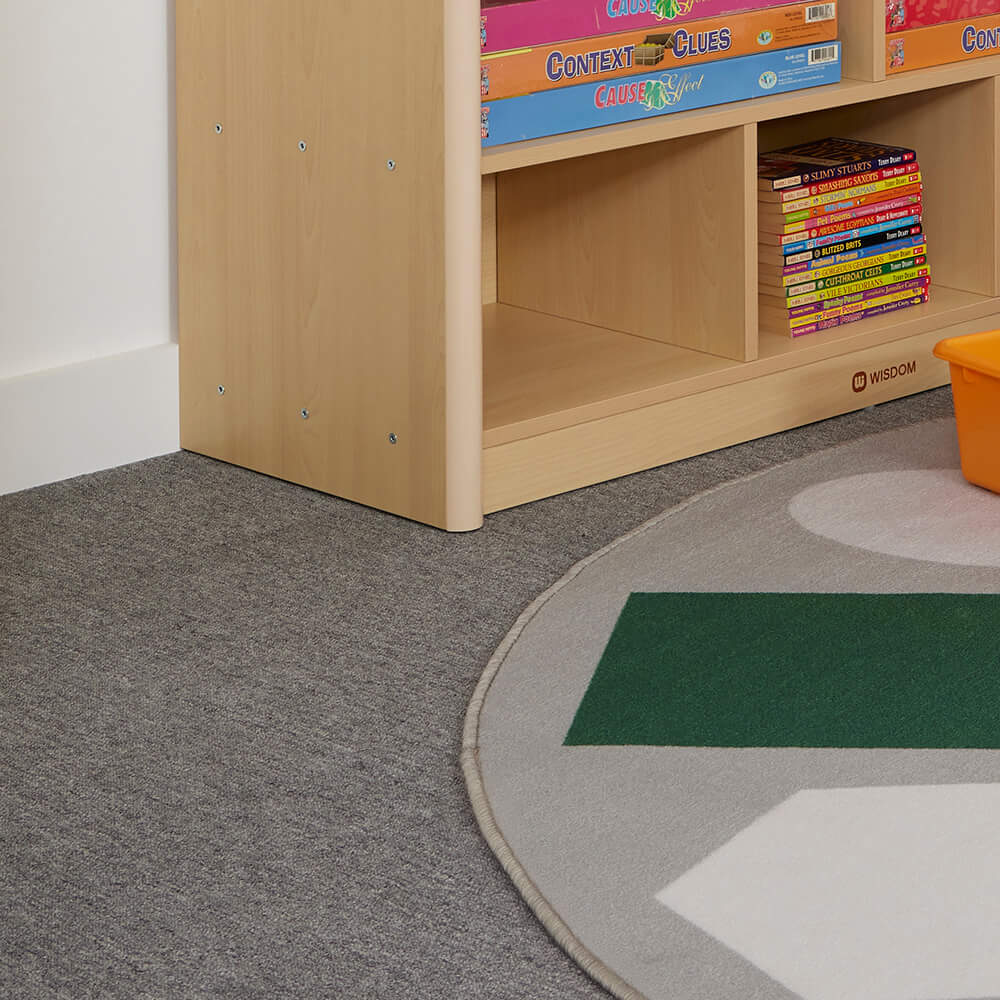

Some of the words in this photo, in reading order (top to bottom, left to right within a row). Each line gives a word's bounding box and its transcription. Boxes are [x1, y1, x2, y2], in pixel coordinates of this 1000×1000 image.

[545, 44, 635, 81] CONTEXT
[672, 28, 731, 58] CLUES
[594, 81, 646, 109] CAUSE
[661, 73, 704, 105] Effect
[810, 167, 836, 180] SLIMY
[837, 160, 872, 176] STUARTS
[853, 171, 879, 185] SAXONS
[822, 243, 845, 256] BLITZED
[846, 239, 862, 250] BRITS
[825, 270, 864, 287] CUT-THROAT
[864, 265, 882, 278] CELTS
[827, 287, 842, 298] VILE
[843, 278, 883, 295] VICTORIANS
[869, 360, 916, 385] WISDOM
